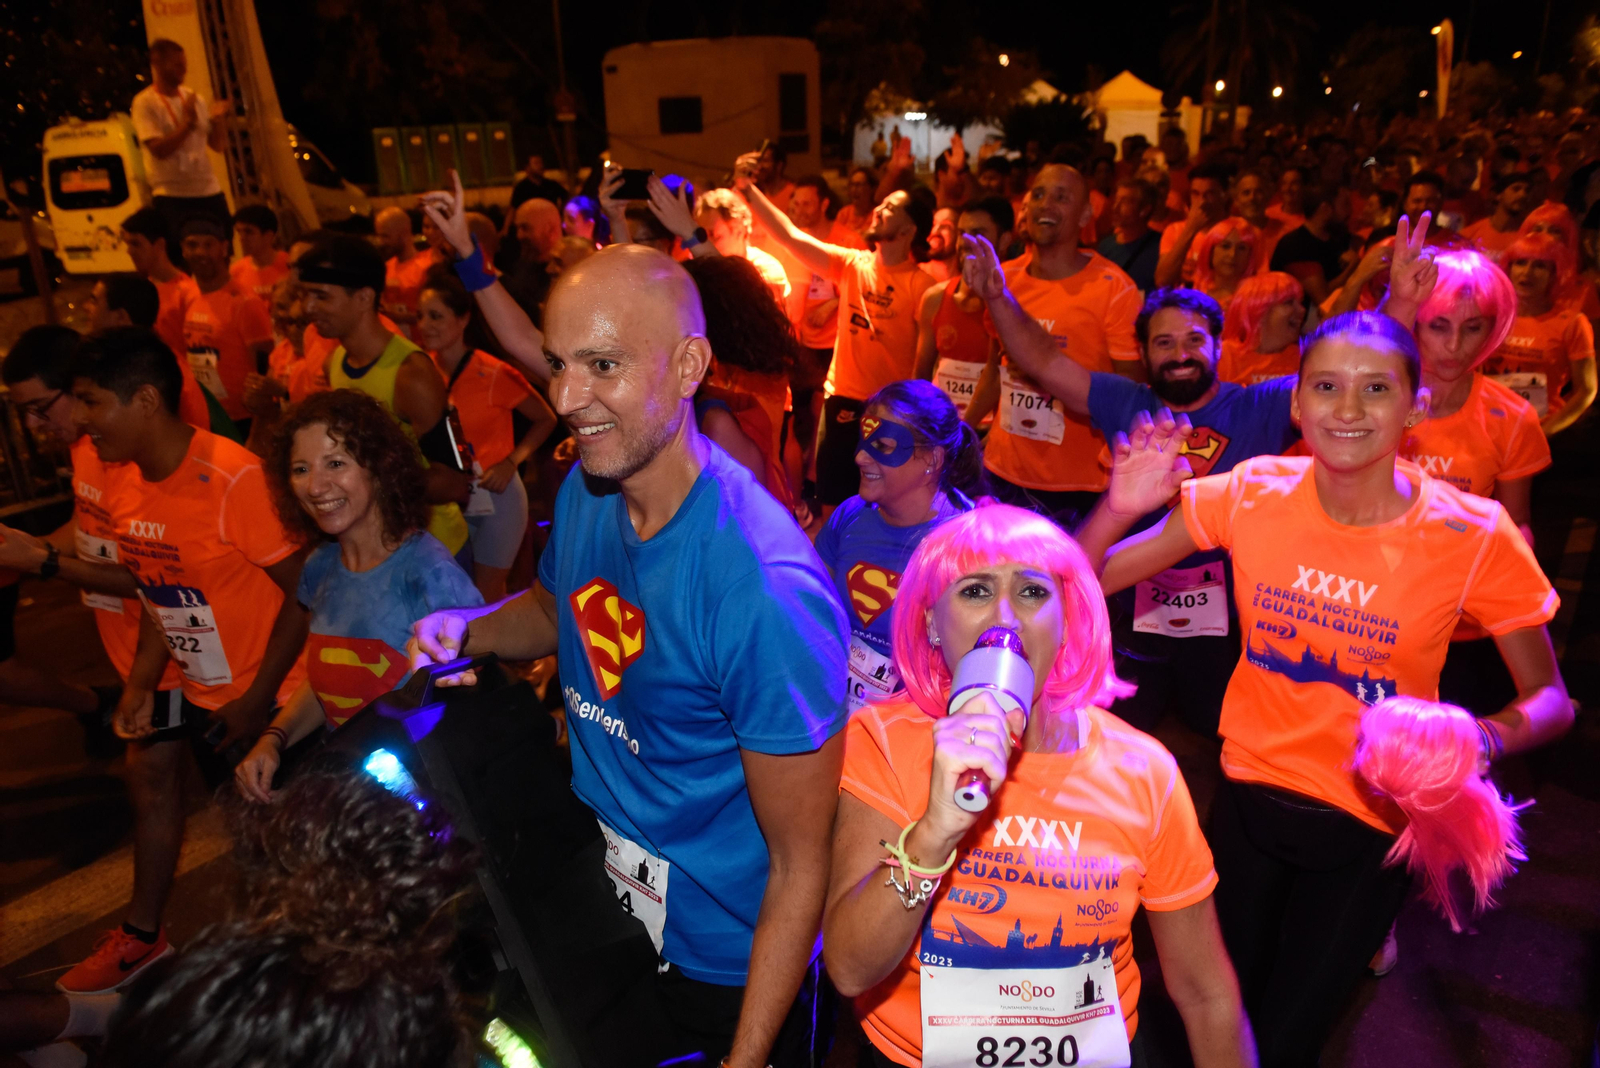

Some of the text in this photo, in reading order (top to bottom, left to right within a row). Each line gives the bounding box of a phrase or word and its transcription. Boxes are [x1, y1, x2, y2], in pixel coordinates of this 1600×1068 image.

[946, 381, 974, 395] 1244
[1010, 392, 1054, 411] 17074
[129, 520, 166, 540] XXXV
[1291, 564, 1379, 607] XXXV
[1151, 587, 1208, 608] 22403
[1252, 593, 1260, 607] DEL
[1256, 583, 1400, 630] CARRERA NOCTURNA
[1261, 597, 1397, 645] GUADALQUIVIR
[993, 815, 1083, 851] XXXV
[962, 846, 1123, 871] ARRERA NOCTURNA
[957, 859, 1120, 891] GUADALQUIVIR
[923, 952, 953, 967] 2023
[932, 1017, 953, 1025] XXXV
[954, 1017, 986, 1025] CARRERA
[987, 1017, 1025, 1025] NOCTURNA
[1039, 1013, 1086, 1025] GUADALQUIVIR
[1085, 1011, 1096, 1019] KH7
[1096, 1007, 1111, 1016] 2023
[975, 1034, 1080, 1068] 8230
